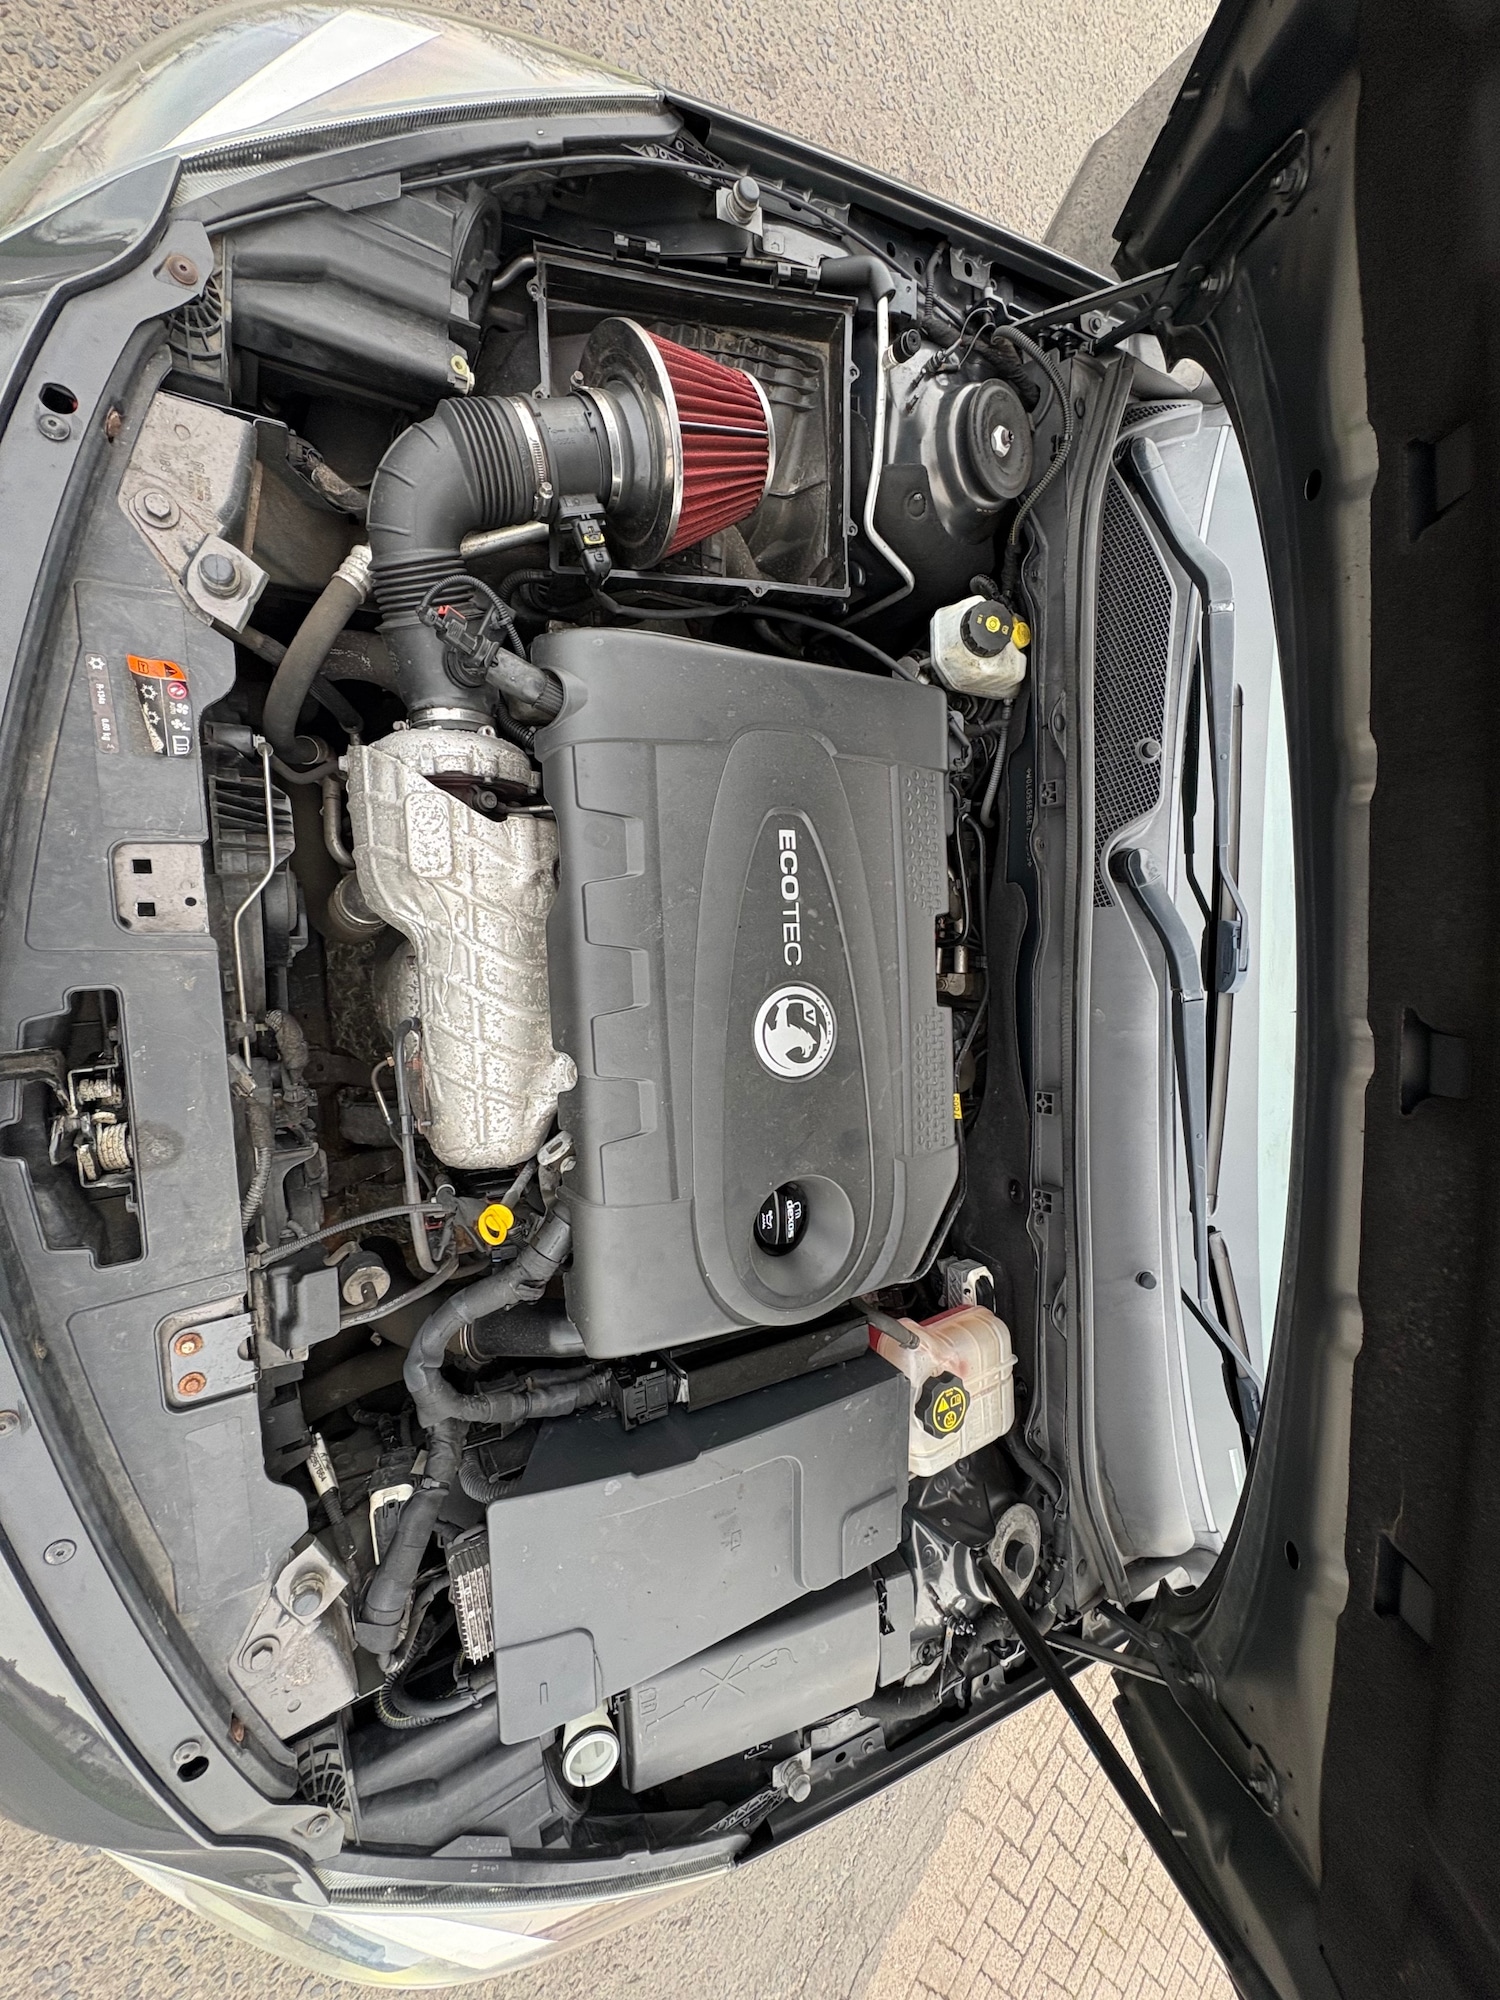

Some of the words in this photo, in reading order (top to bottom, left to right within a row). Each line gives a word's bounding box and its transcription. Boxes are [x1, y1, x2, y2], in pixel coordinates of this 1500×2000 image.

[95, 683, 106, 705] R-134a
[101, 732, 112, 741] kg
[778, 829, 802, 966] ECOTEC
[815, 998, 833, 1060] VAUXHALL
[786, 1200, 796, 1239] dexos
